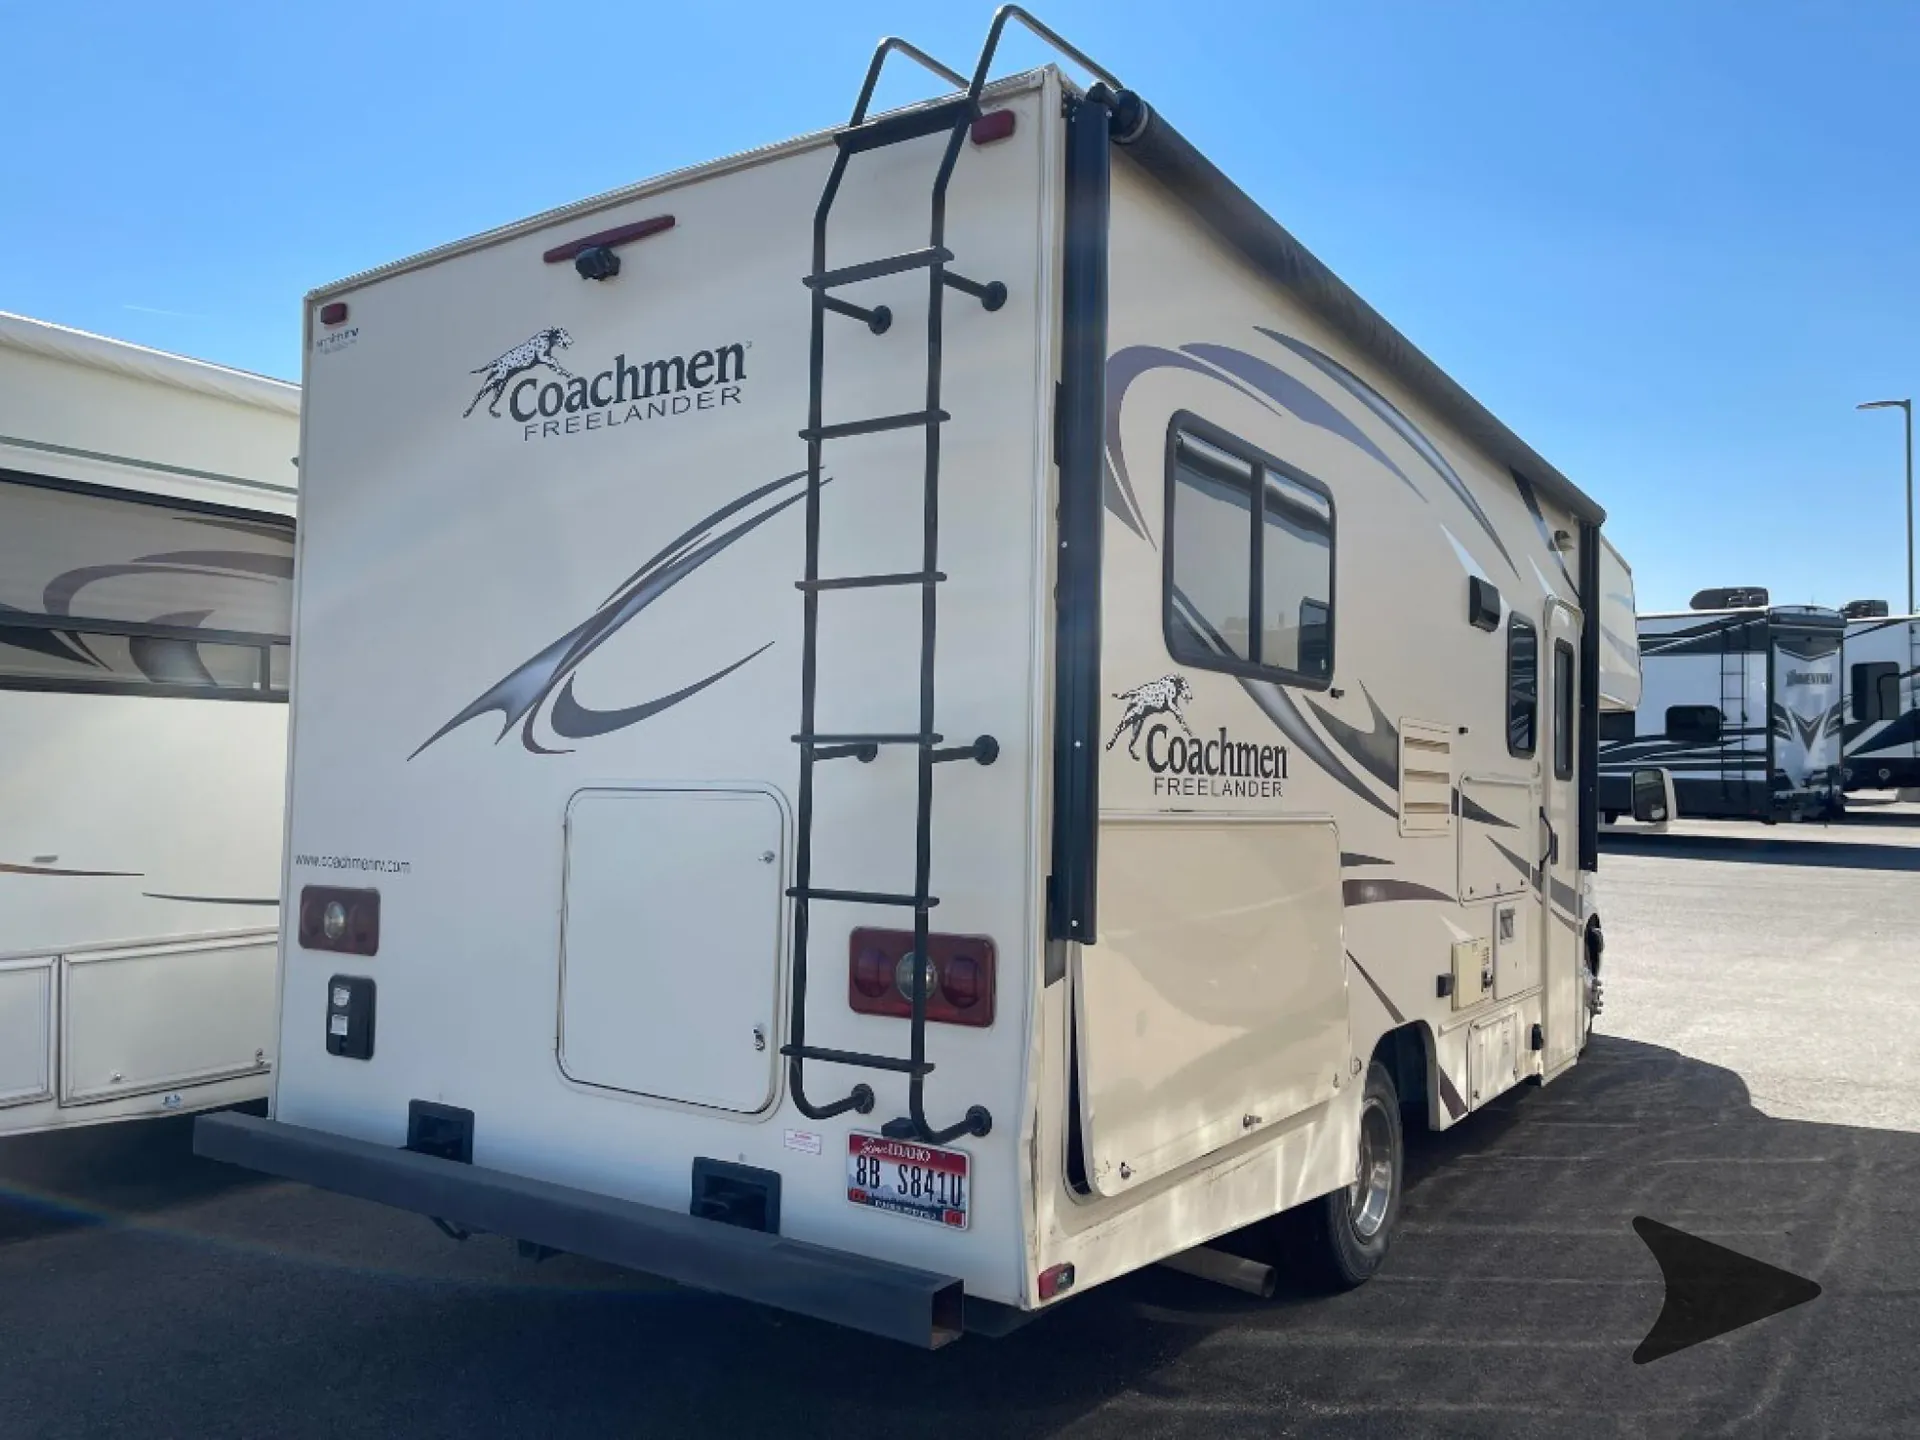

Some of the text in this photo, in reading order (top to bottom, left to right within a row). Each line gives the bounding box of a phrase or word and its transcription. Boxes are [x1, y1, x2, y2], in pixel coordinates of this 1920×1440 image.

[509, 342, 747, 422] Coachmen
[524, 387, 742, 441] FREELANDER
[1147, 724, 1288, 779] Coachmen
[1154, 777, 1283, 798] FREELANDER
[856, 1154, 880, 1190] 8B
